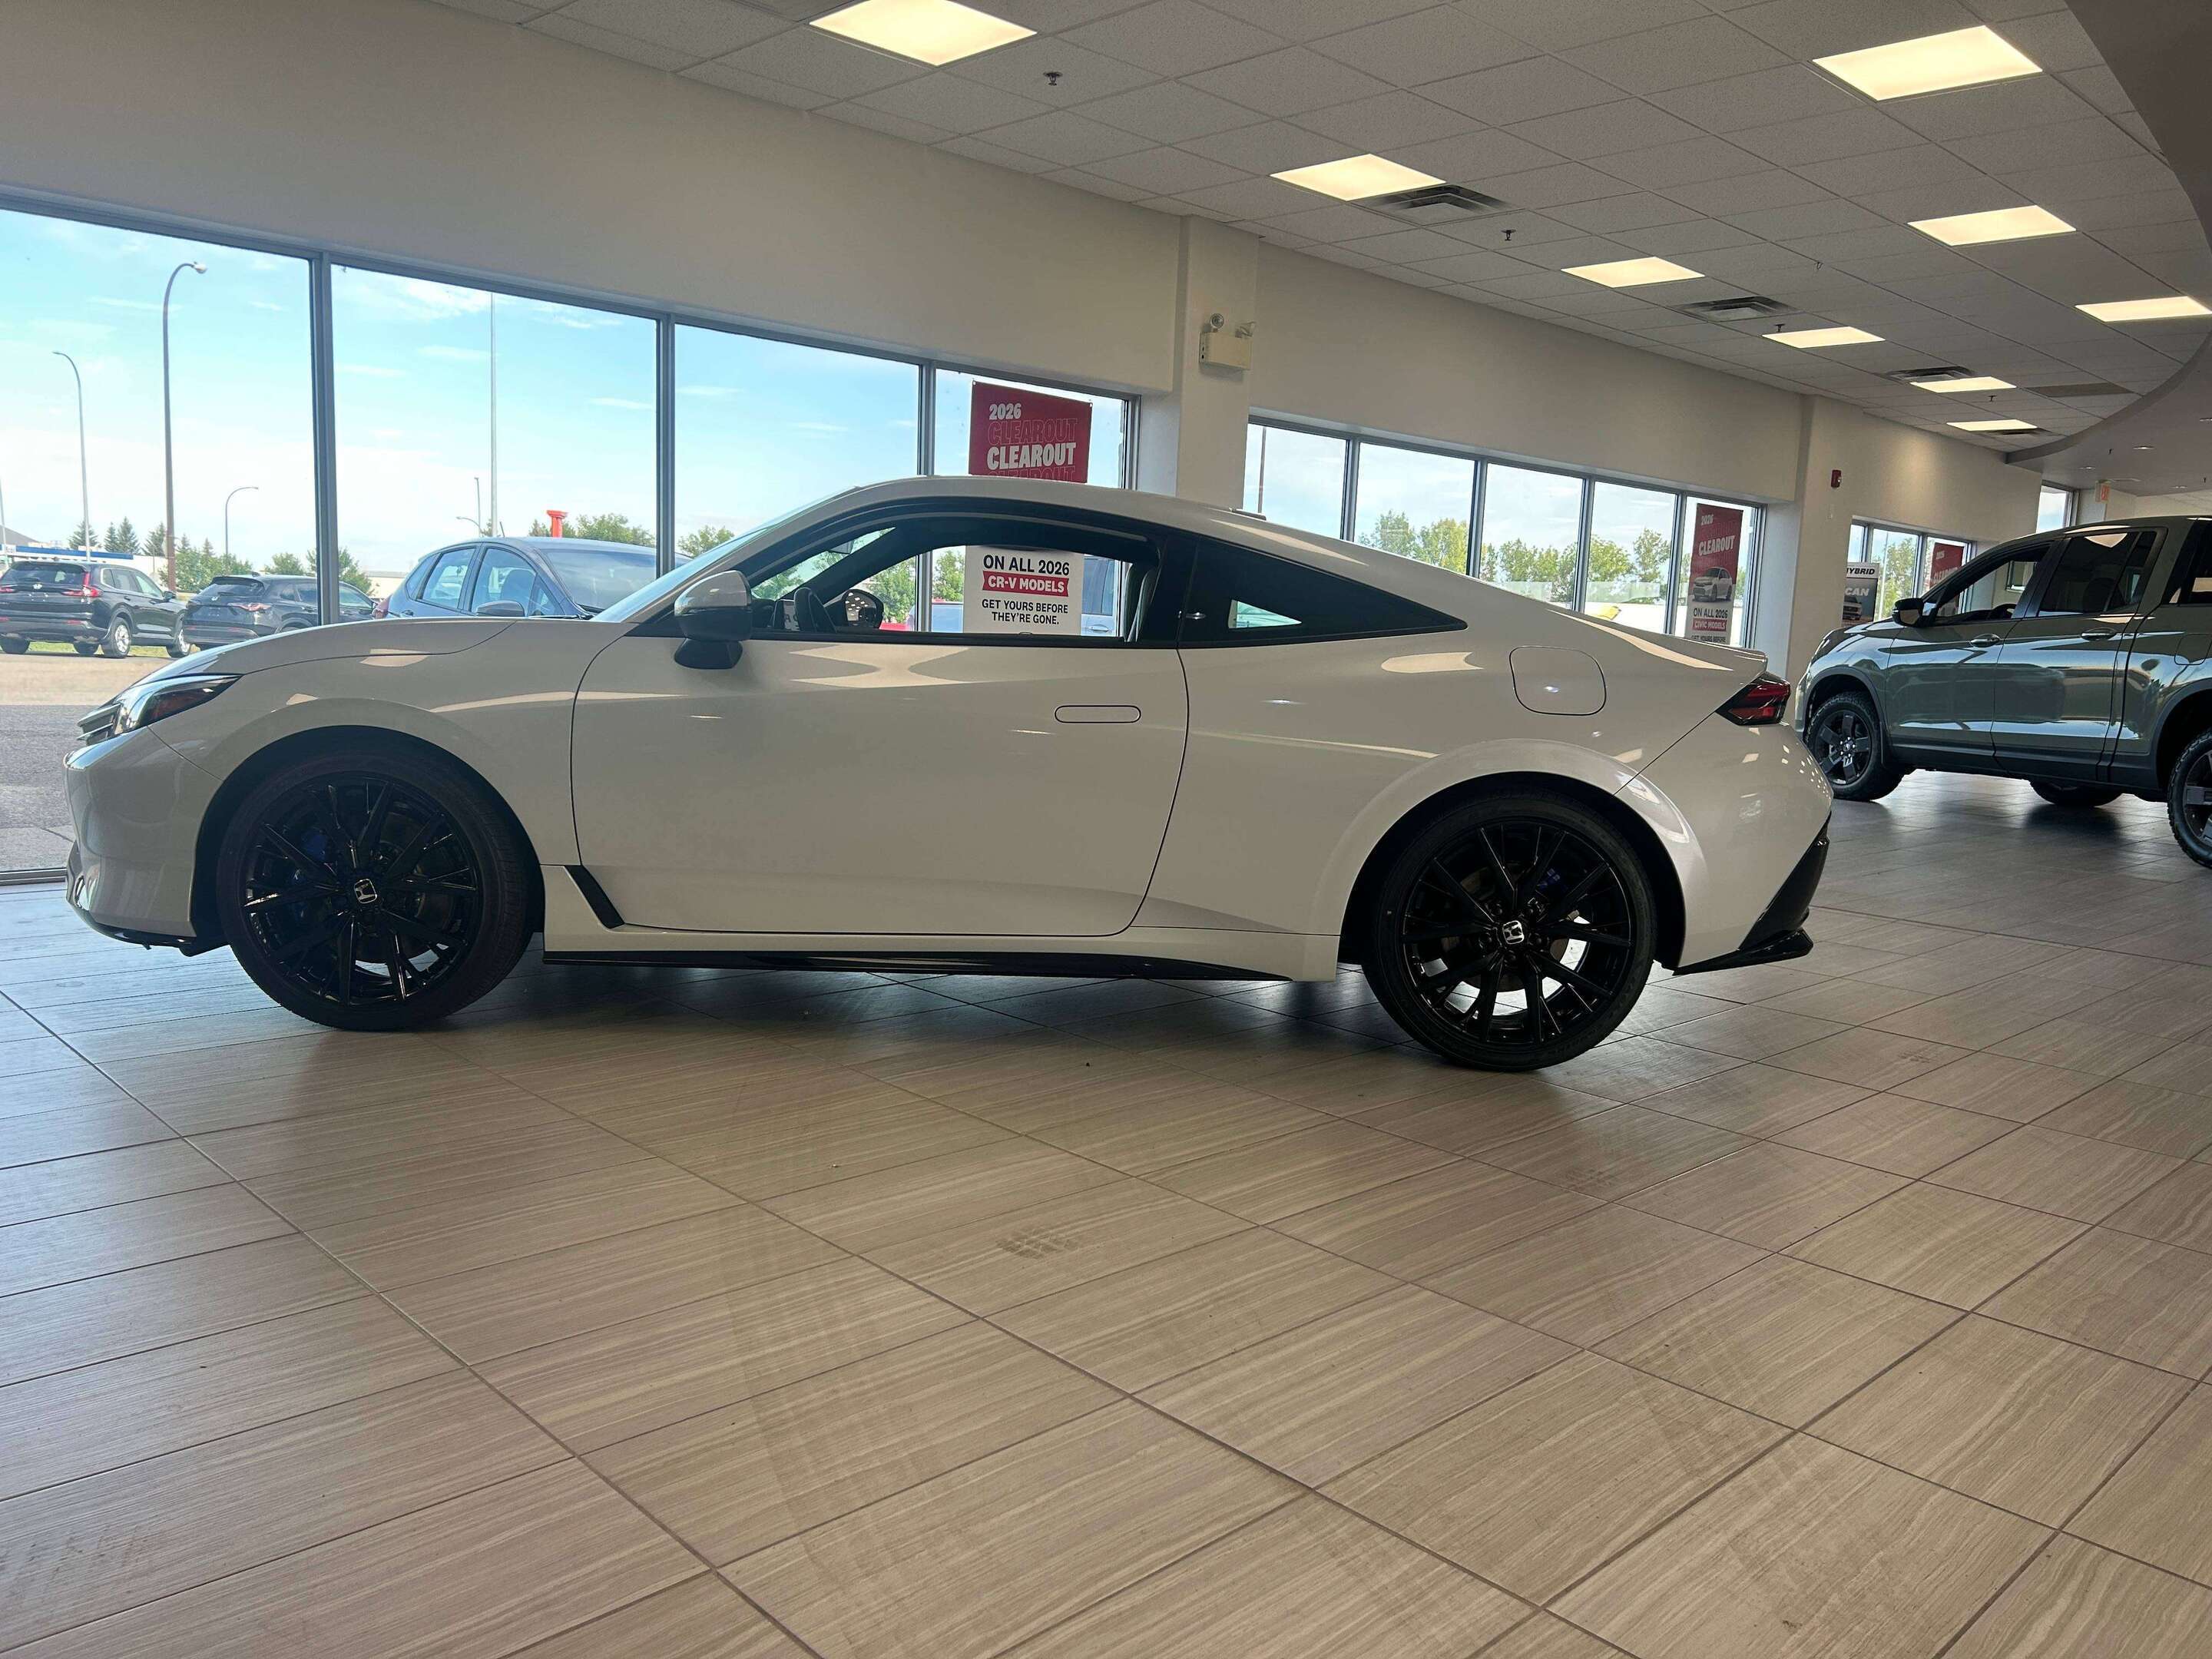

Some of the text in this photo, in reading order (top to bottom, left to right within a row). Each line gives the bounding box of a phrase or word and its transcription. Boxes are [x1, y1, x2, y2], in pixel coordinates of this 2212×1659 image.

[989, 403, 1022, 420] 2026
[987, 442, 1076, 470] CLEAROUT
[1698, 535, 1736, 556] CLEAROUT
[983, 555, 1069, 575] ON ALL 2026
[988, 575, 1065, 593] CR-V MODELS
[982, 599, 1068, 614] GET YOURS BEFORE
[1693, 608, 1702, 617] ON
[1704, 608, 1714, 618] ALL
[992, 611, 1059, 624] THEY'RE GONE.
